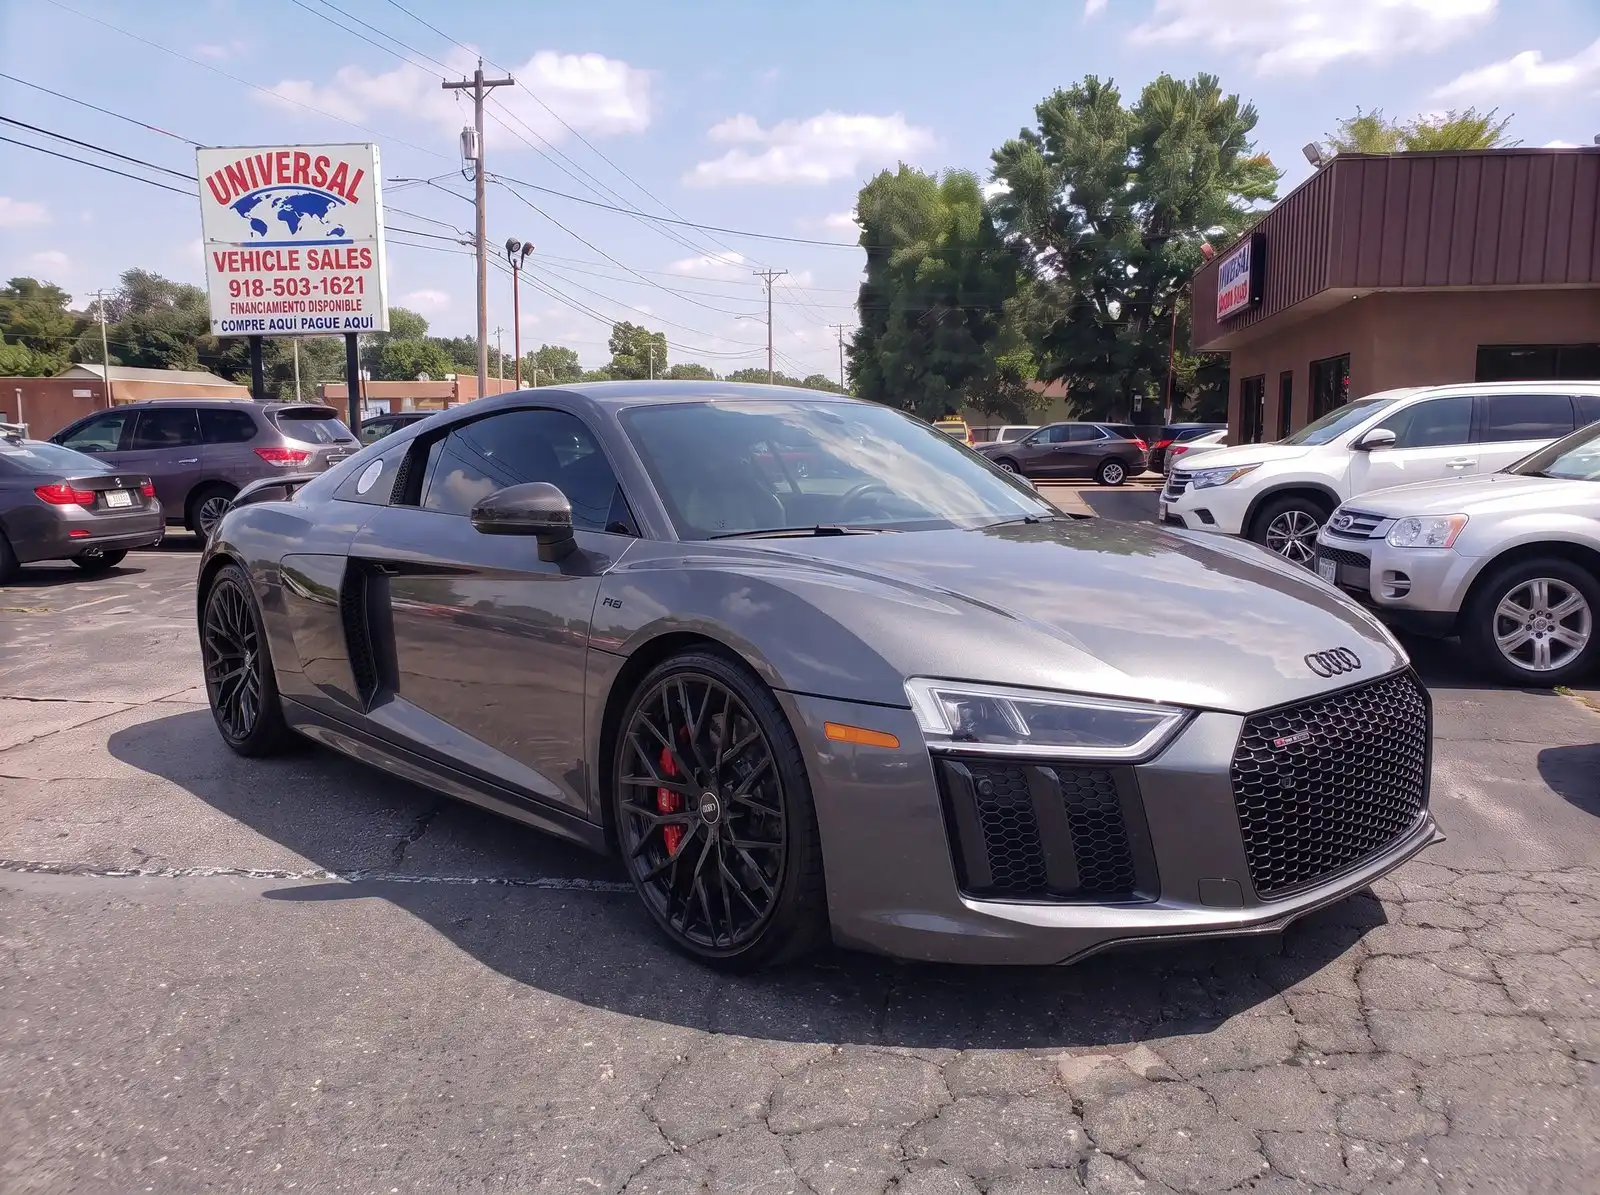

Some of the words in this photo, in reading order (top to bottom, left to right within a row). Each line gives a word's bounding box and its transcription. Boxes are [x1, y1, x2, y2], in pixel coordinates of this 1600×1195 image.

[205, 151, 365, 206] UNIVERSAL
[213, 250, 300, 273] VEHICLE
[307, 248, 372, 271] SALES
[229, 276, 364, 298] 918-503-1621
[230, 300, 306, 315] FINANCIAMIENTO
[309, 299, 362, 313] DISPONIBLE
[221, 318, 265, 332] COMPRE
[301, 317, 340, 330] PAGUE
[602, 597, 622, 608] R8
